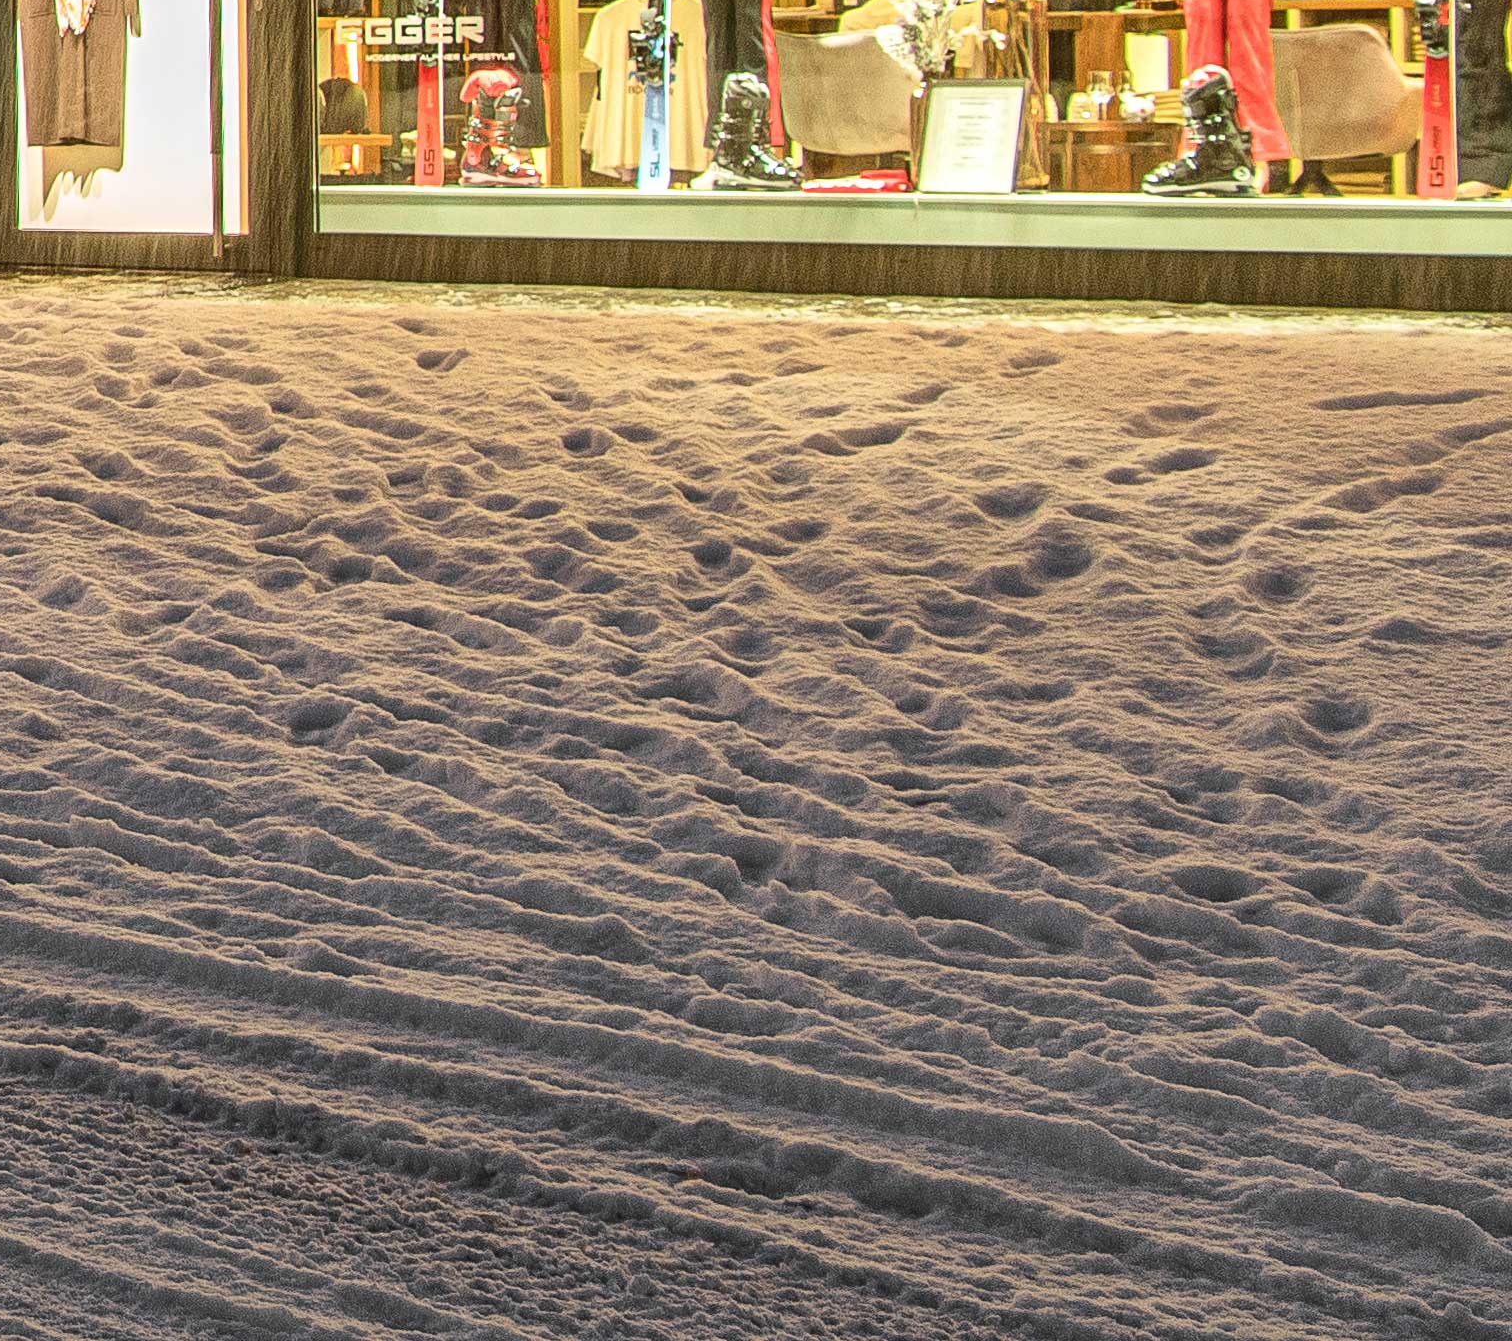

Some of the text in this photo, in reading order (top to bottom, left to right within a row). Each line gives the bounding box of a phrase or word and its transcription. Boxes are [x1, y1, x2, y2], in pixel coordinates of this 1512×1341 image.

[336, 16, 485, 45] EGGER
[420, 52, 461, 62] ALPNER
[463, 52, 515, 61] LIFESTYLE
[423, 149, 435, 177] GS
[649, 153, 660, 178] SL
[1429, 155, 1444, 187] GS
